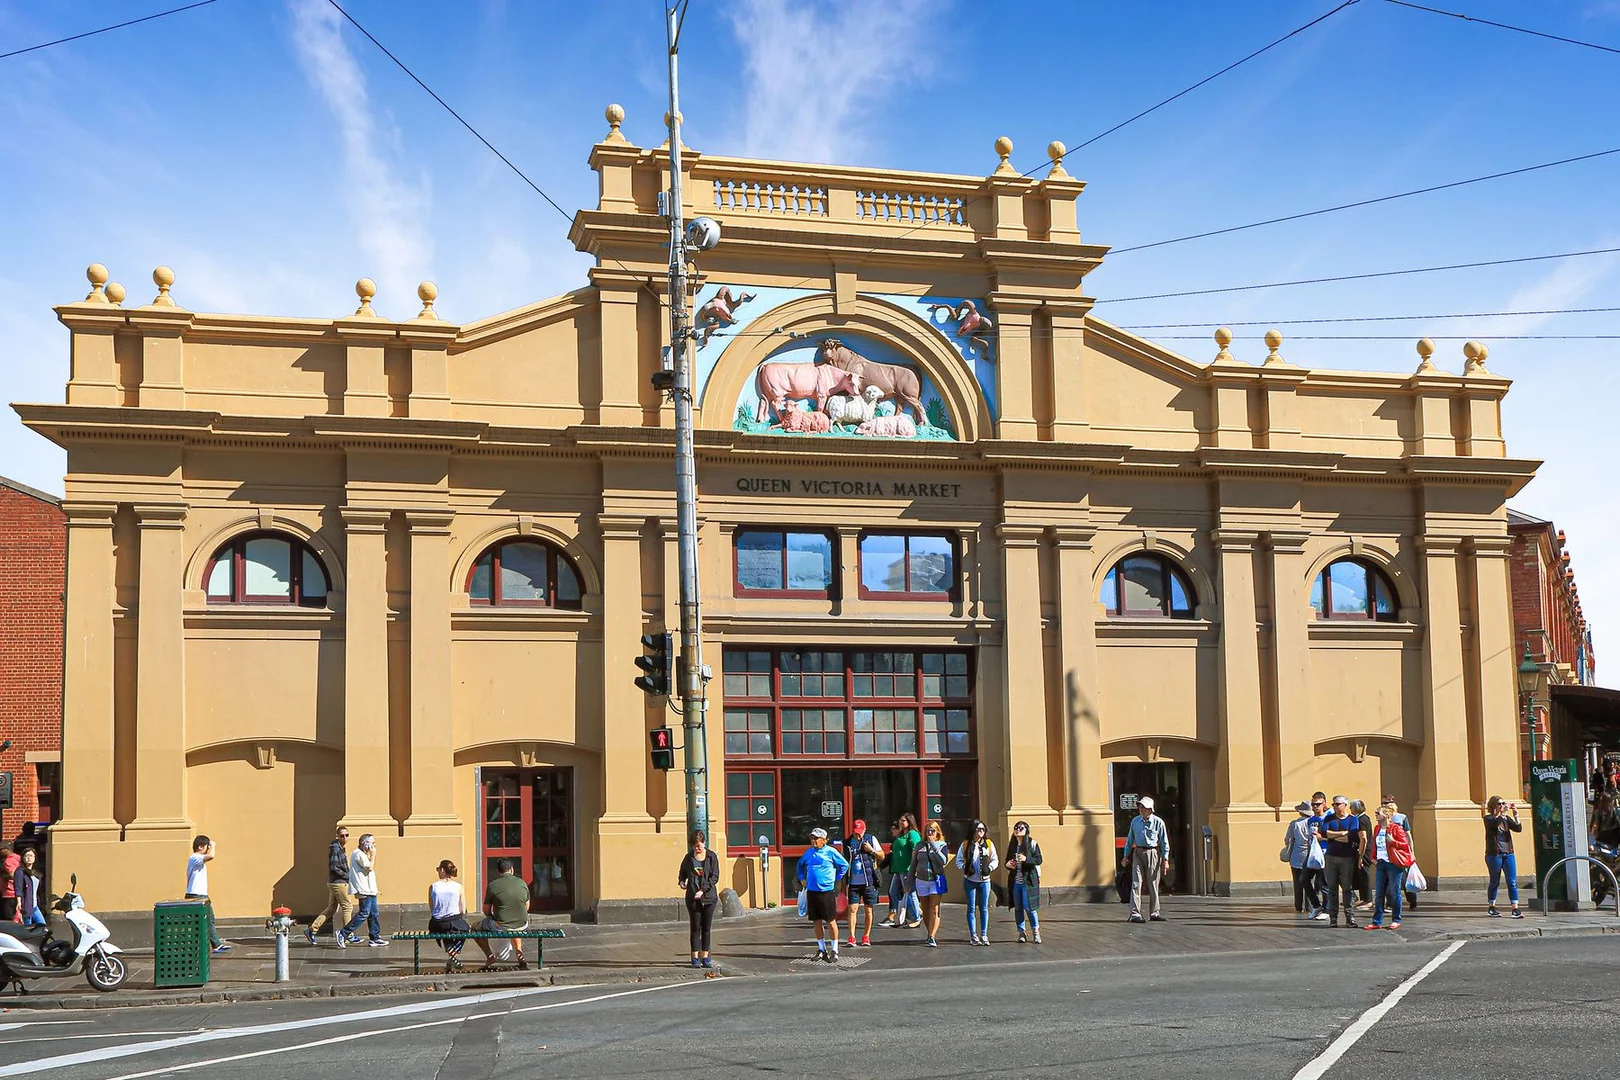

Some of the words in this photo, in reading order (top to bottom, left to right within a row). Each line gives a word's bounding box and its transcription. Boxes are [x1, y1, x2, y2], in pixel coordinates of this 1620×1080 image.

[736, 478, 791, 493] QUEEN
[801, 480, 883, 496] VICTORIA
[893, 482, 962, 498] MARKET
[1564, 791, 1570, 801] ST
[1565, 803, 1573, 848] ELIZABETH
